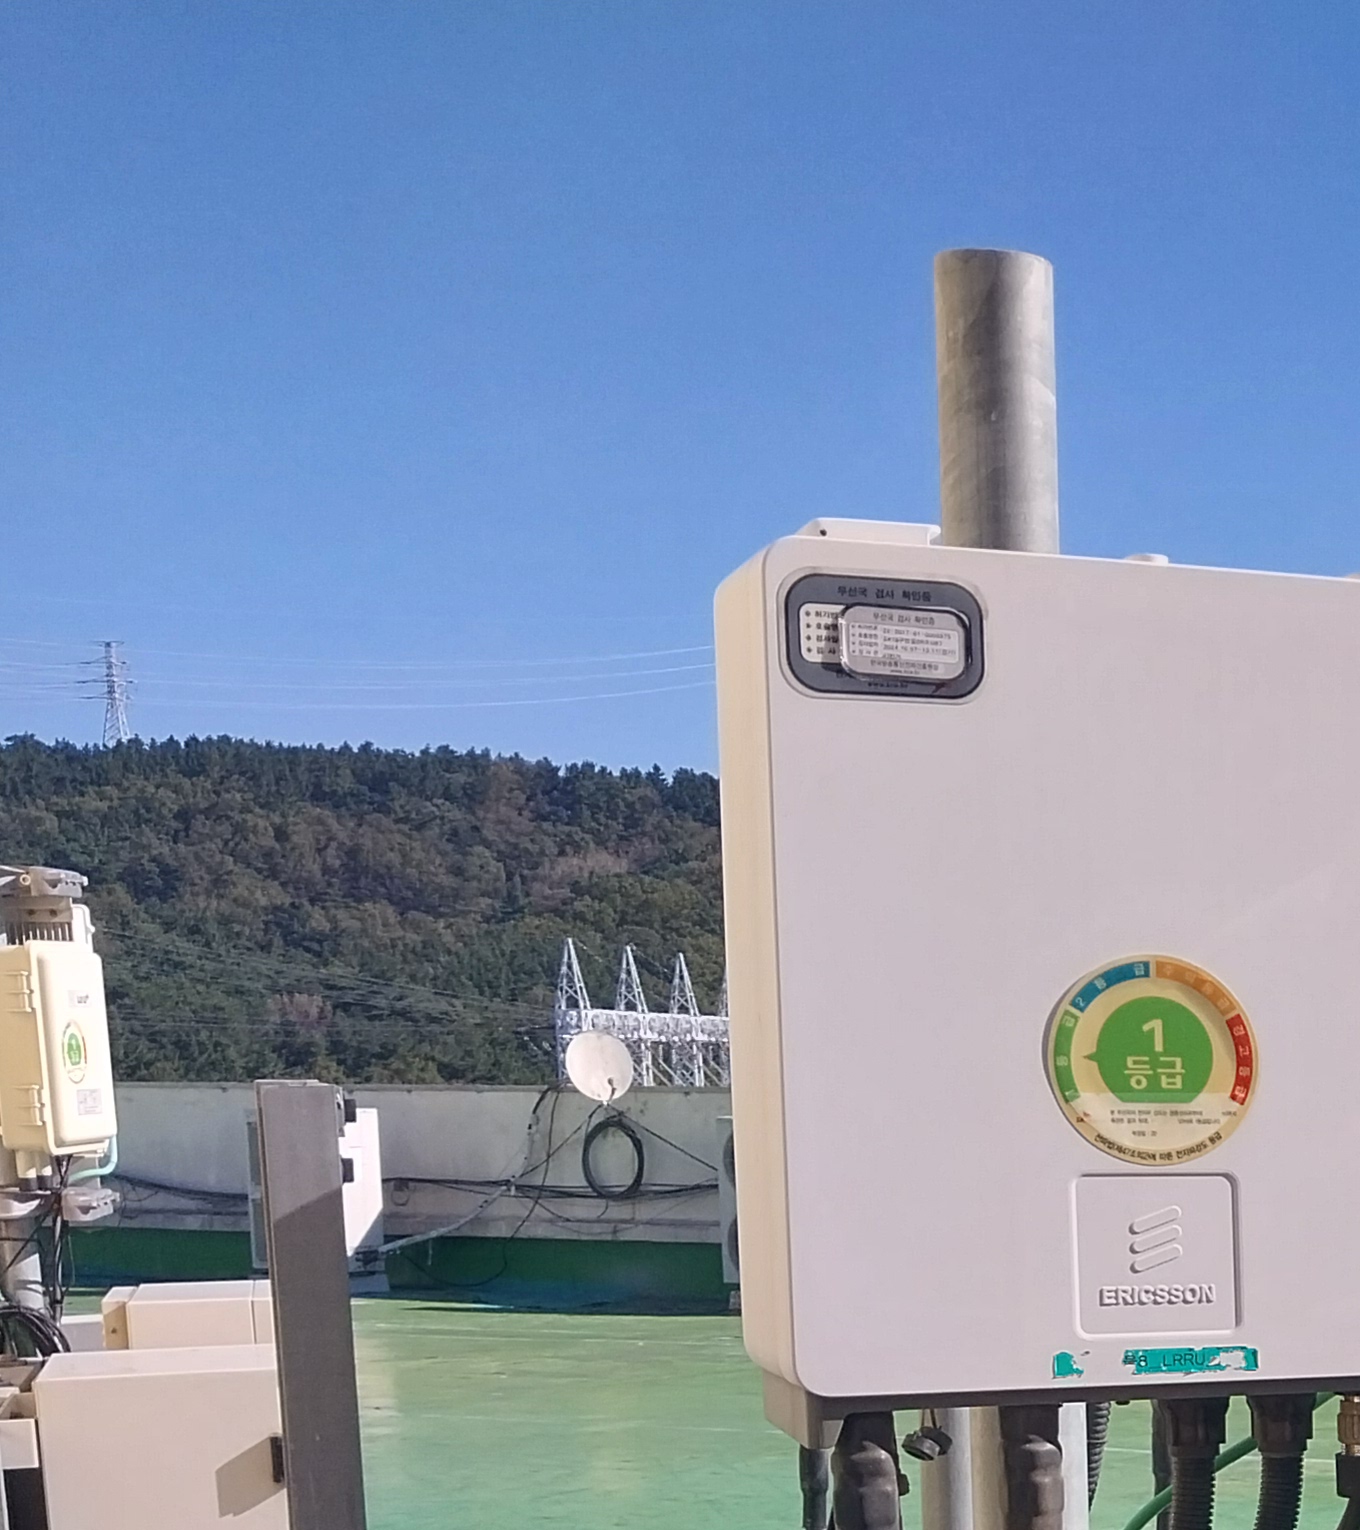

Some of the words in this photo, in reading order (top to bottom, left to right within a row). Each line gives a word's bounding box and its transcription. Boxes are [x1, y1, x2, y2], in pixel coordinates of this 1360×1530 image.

[1142, 1018, 1164, 1052] 1
[1124, 1056, 1186, 1089] 등급
[1100, 1283, 1216, 1306] ERICSSON
